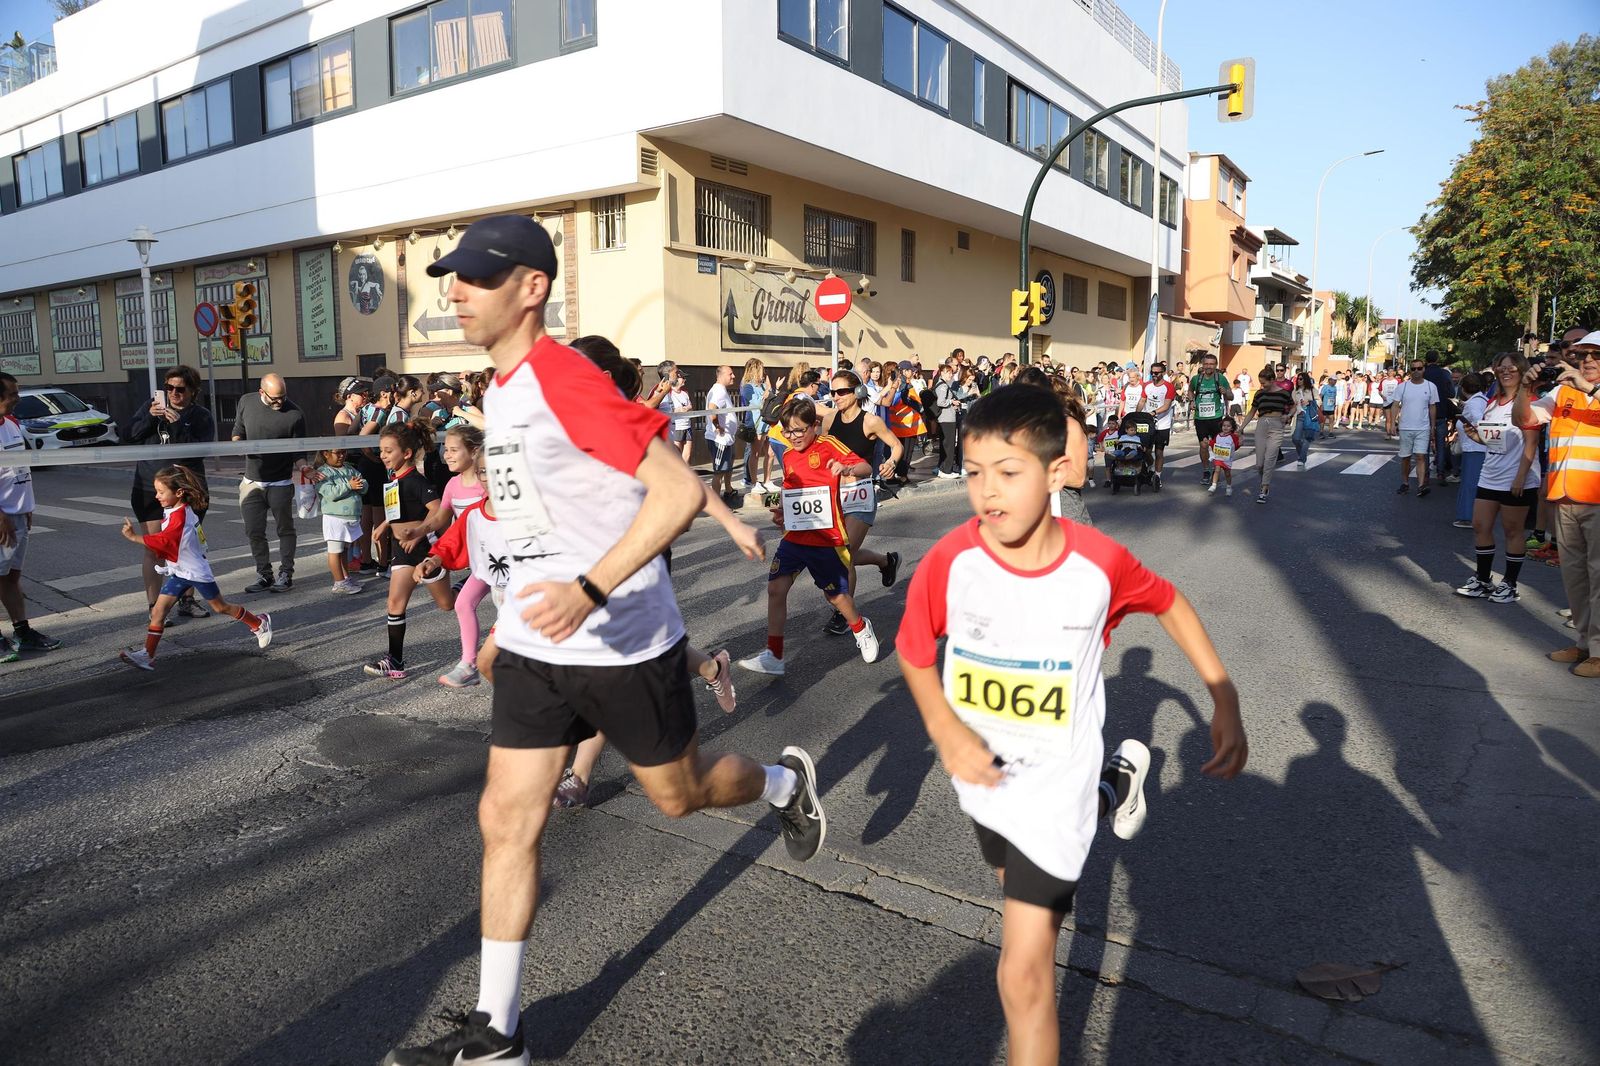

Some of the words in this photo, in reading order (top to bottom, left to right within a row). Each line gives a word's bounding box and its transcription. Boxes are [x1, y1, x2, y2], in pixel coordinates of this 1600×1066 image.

[751, 286, 811, 331] Grand
[1483, 429, 1501, 440] 712
[842, 488, 868, 502] 770
[792, 499, 823, 515] 908
[958, 672, 1066, 721] 1064
